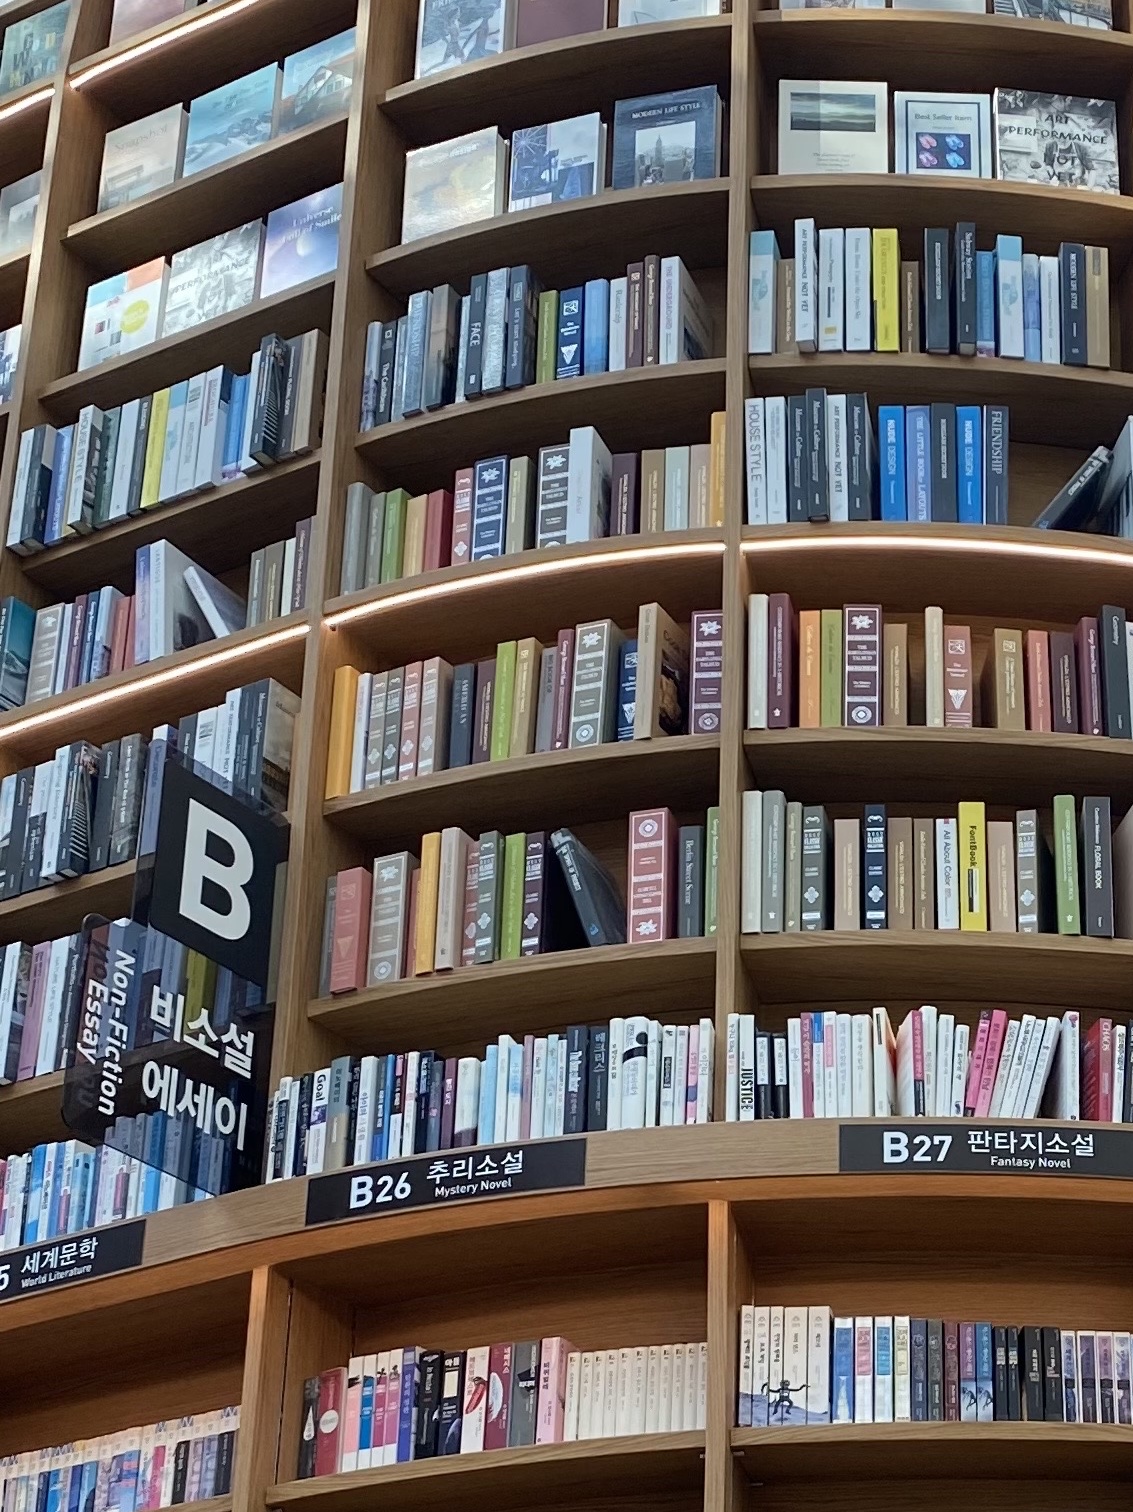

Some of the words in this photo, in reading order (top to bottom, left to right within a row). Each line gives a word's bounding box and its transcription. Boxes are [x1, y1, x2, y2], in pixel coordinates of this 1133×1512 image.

[1007, 126, 1108, 145] PERFORMANCE
[469, 322, 482, 347] FACE
[748, 404, 760, 440] HOUSE
[991, 411, 1003, 475] FRIENDSHIP
[751, 444, 762, 482] STYLE
[968, 825, 978, 867] FontBook
[179, 798, 254, 940] B
[77, 977, 109, 1066] Essay
[98, 948, 136, 1116] Non-Fiction
[150, 984, 255, 1079] 비소설
[1101, 1022, 1110, 1051] CHAOS
[141, 1058, 247, 1151] 에세이
[315, 1074, 326, 1102] Goal
[883, 1131, 953, 1163] B27
[967, 1130, 1095, 1157] 판타지소설
[426, 1150, 523, 1184] 추리소설
[990, 1156, 1036, 1170] Fantasy
[1038, 1157, 1071, 1169] Novel
[350, 1172, 411, 1210] B26
[435, 1183, 479, 1198] Mystery
[480, 1177, 512, 1191] Novel
[21, 1237, 98, 1273] 세계문학
[21, 1273, 48, 1288] World
